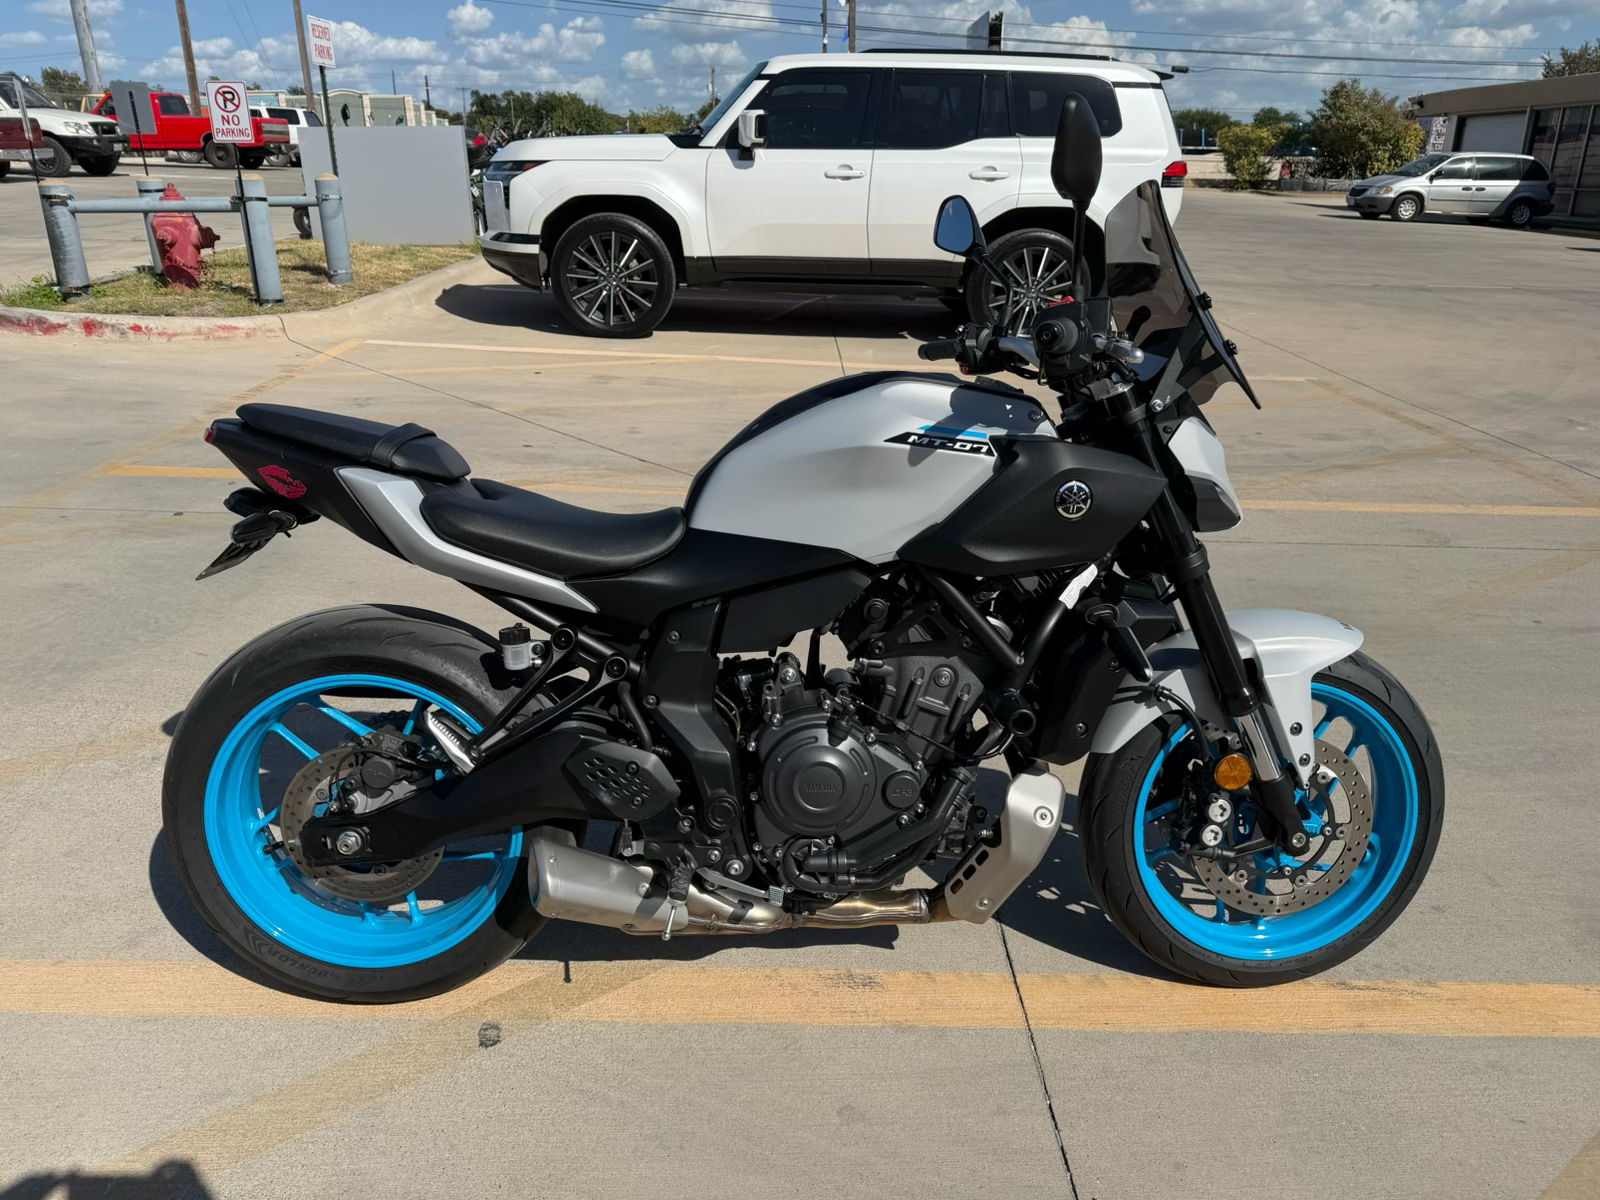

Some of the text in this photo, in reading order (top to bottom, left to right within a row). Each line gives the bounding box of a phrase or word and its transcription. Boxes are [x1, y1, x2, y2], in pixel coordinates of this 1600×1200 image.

[311, 23, 330, 41] RESERVED
[314, 43, 332, 61] PARKING
[221, 114, 240, 126] NO
[215, 127, 250, 138] PARKING
[907, 435, 988, 453] MT-07
[804, 783, 835, 792] YAMAHA
[267, 947, 331, 977] DUNLOP
